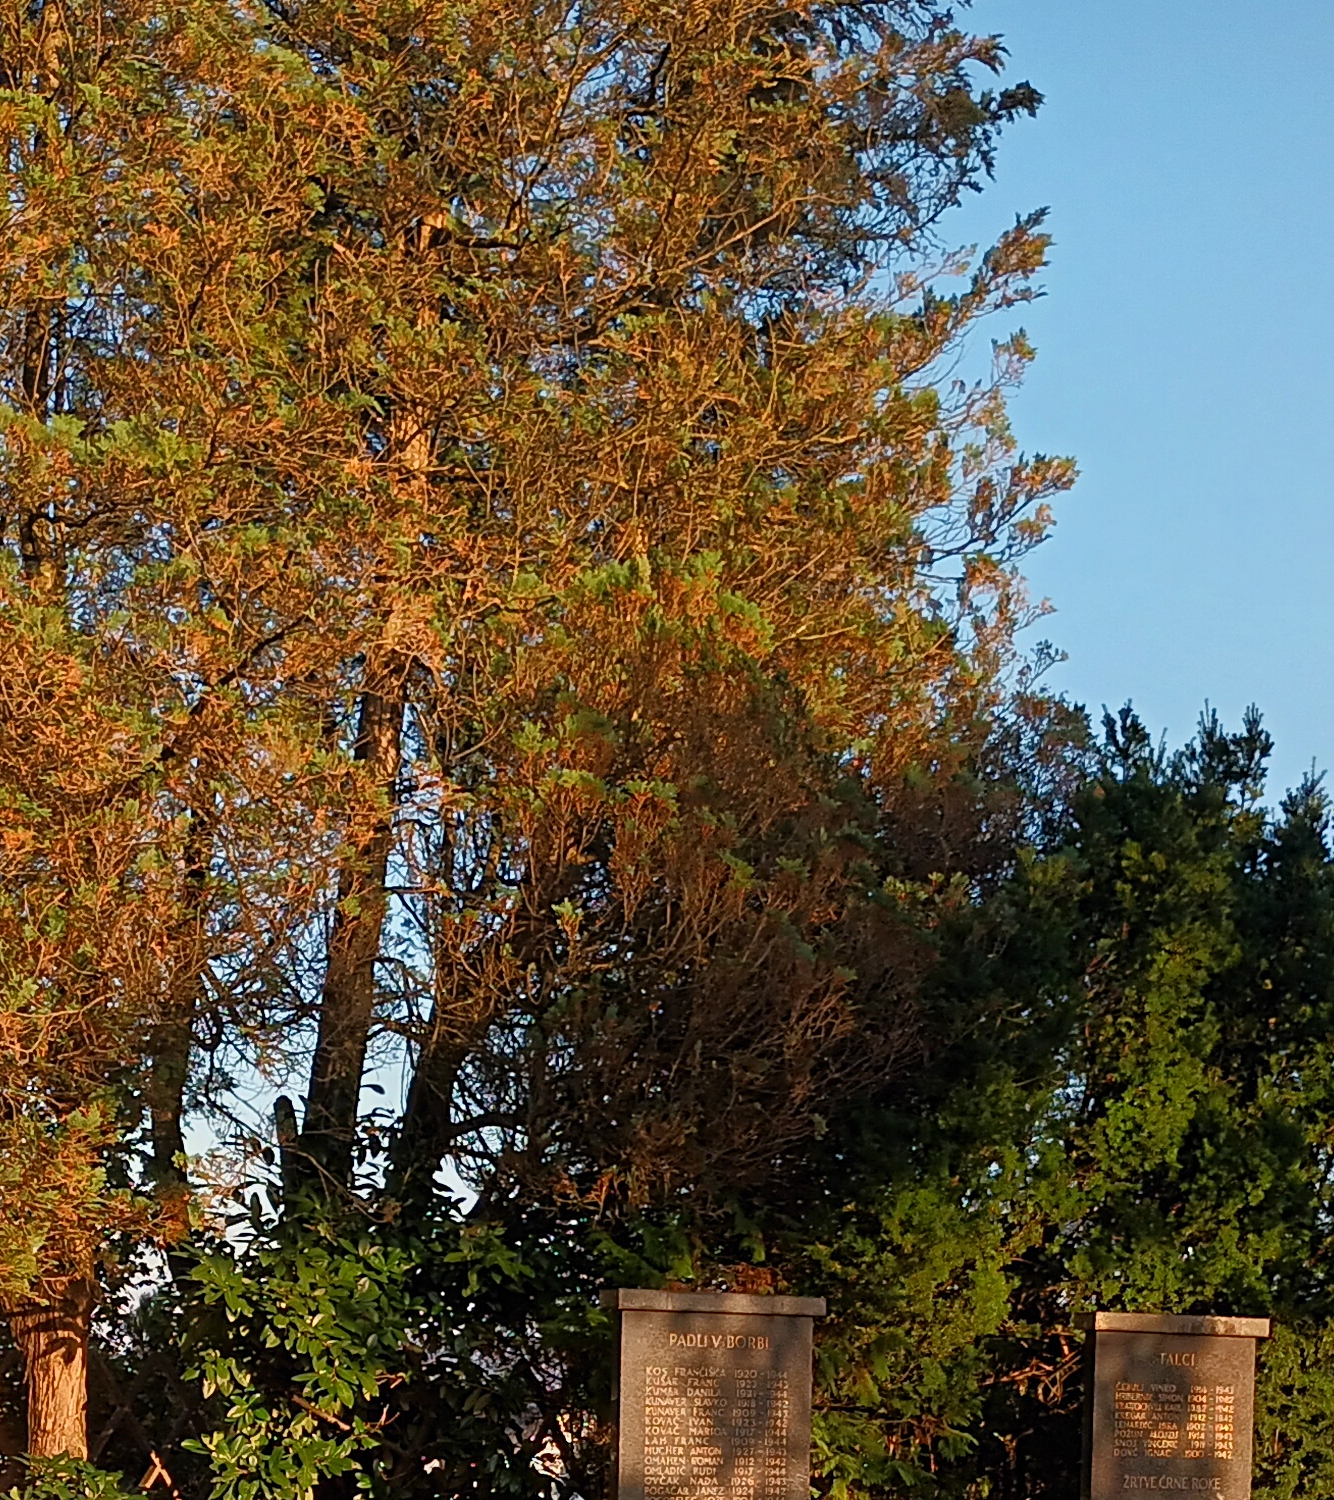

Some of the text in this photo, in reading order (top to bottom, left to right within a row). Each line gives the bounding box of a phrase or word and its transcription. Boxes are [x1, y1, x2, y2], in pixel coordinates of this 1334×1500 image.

[670, 1333, 769, 1350] PADLI V BORBI
[1160, 1353, 1195, 1366] TALCI
